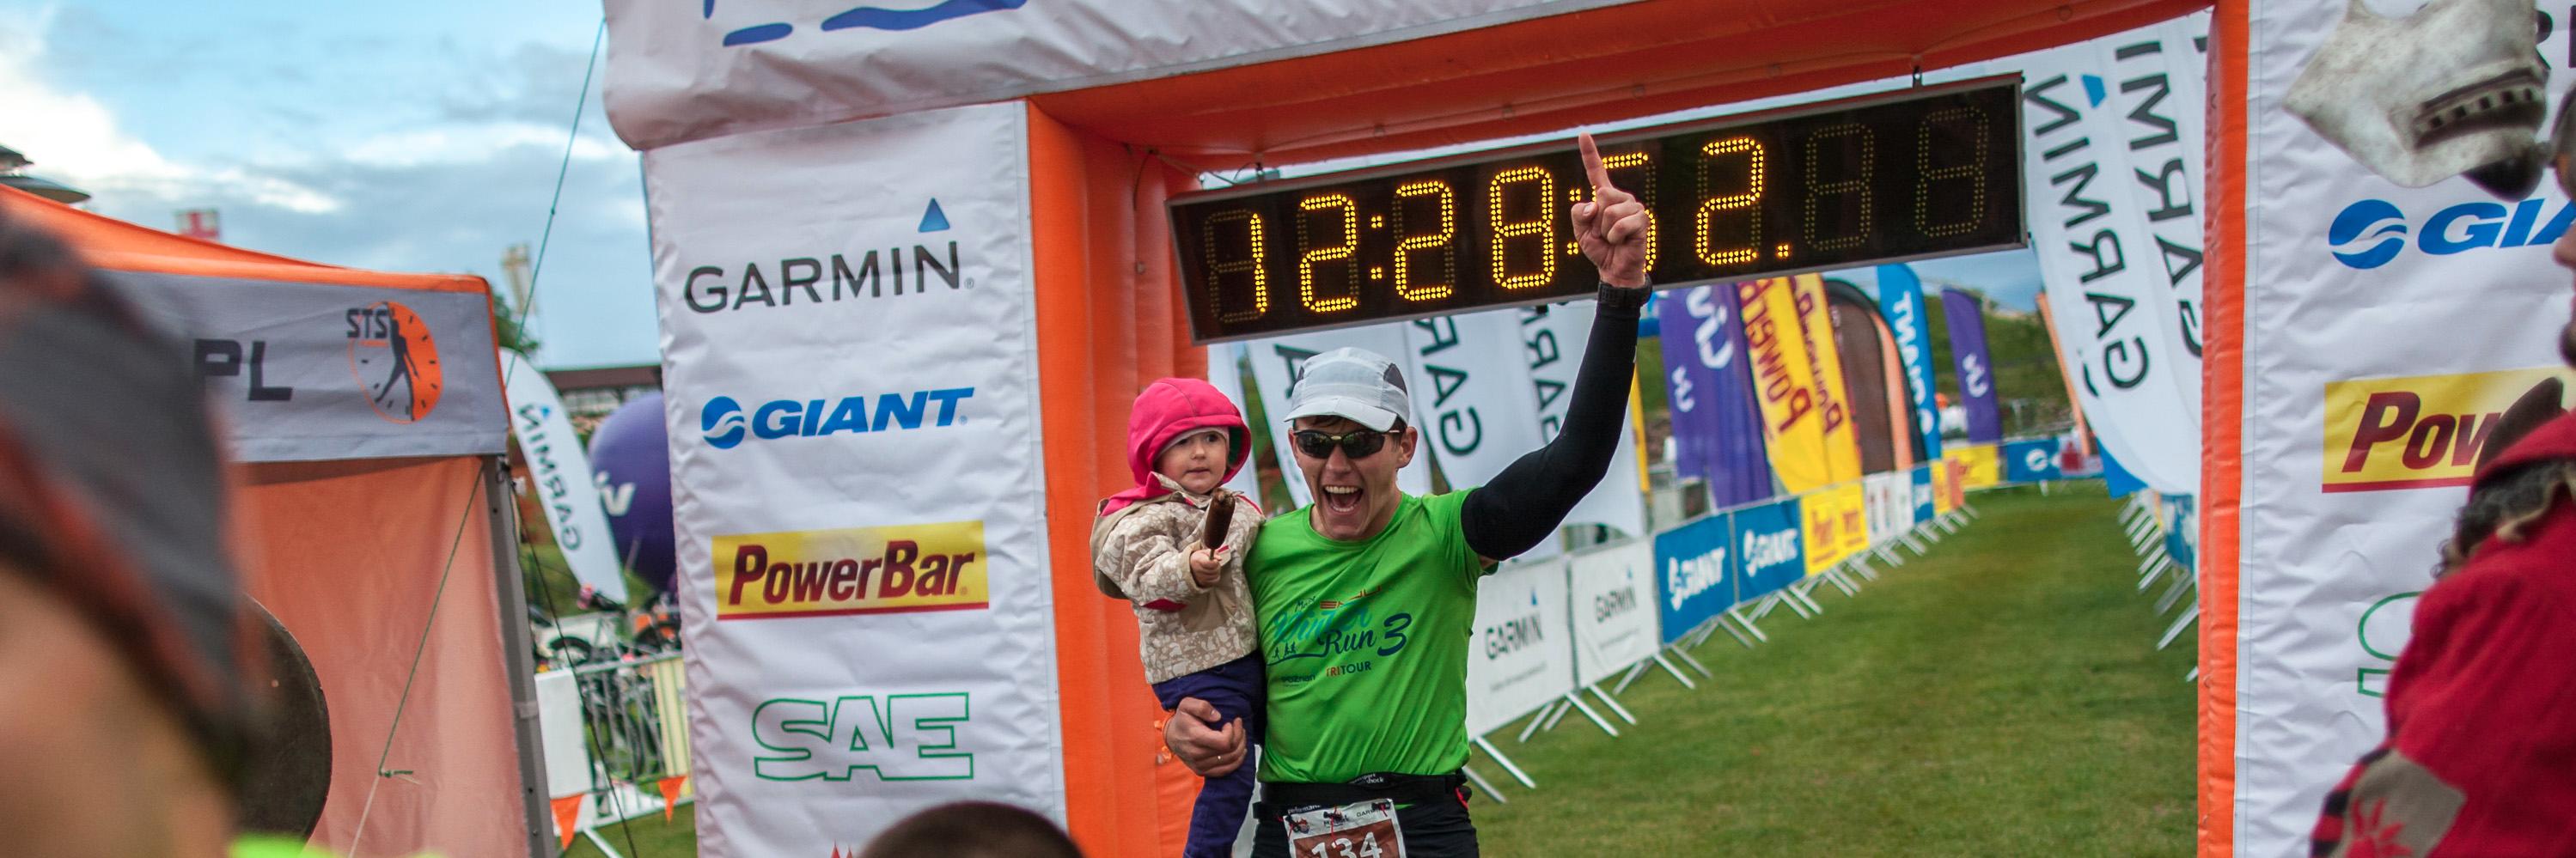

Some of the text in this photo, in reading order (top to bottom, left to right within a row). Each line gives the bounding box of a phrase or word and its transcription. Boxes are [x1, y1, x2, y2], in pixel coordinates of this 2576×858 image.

[684, 240, 960, 313] GARMIN
[347, 308, 388, 339] STS
[752, 387, 974, 440] GIANT
[729, 539, 974, 605] PowerBar
[1316, 612, 1413, 658] Run 3
[1486, 612, 1543, 660] GARMIN
[752, 692, 974, 781] SAE
[1311, 831, 1383, 858] 134
